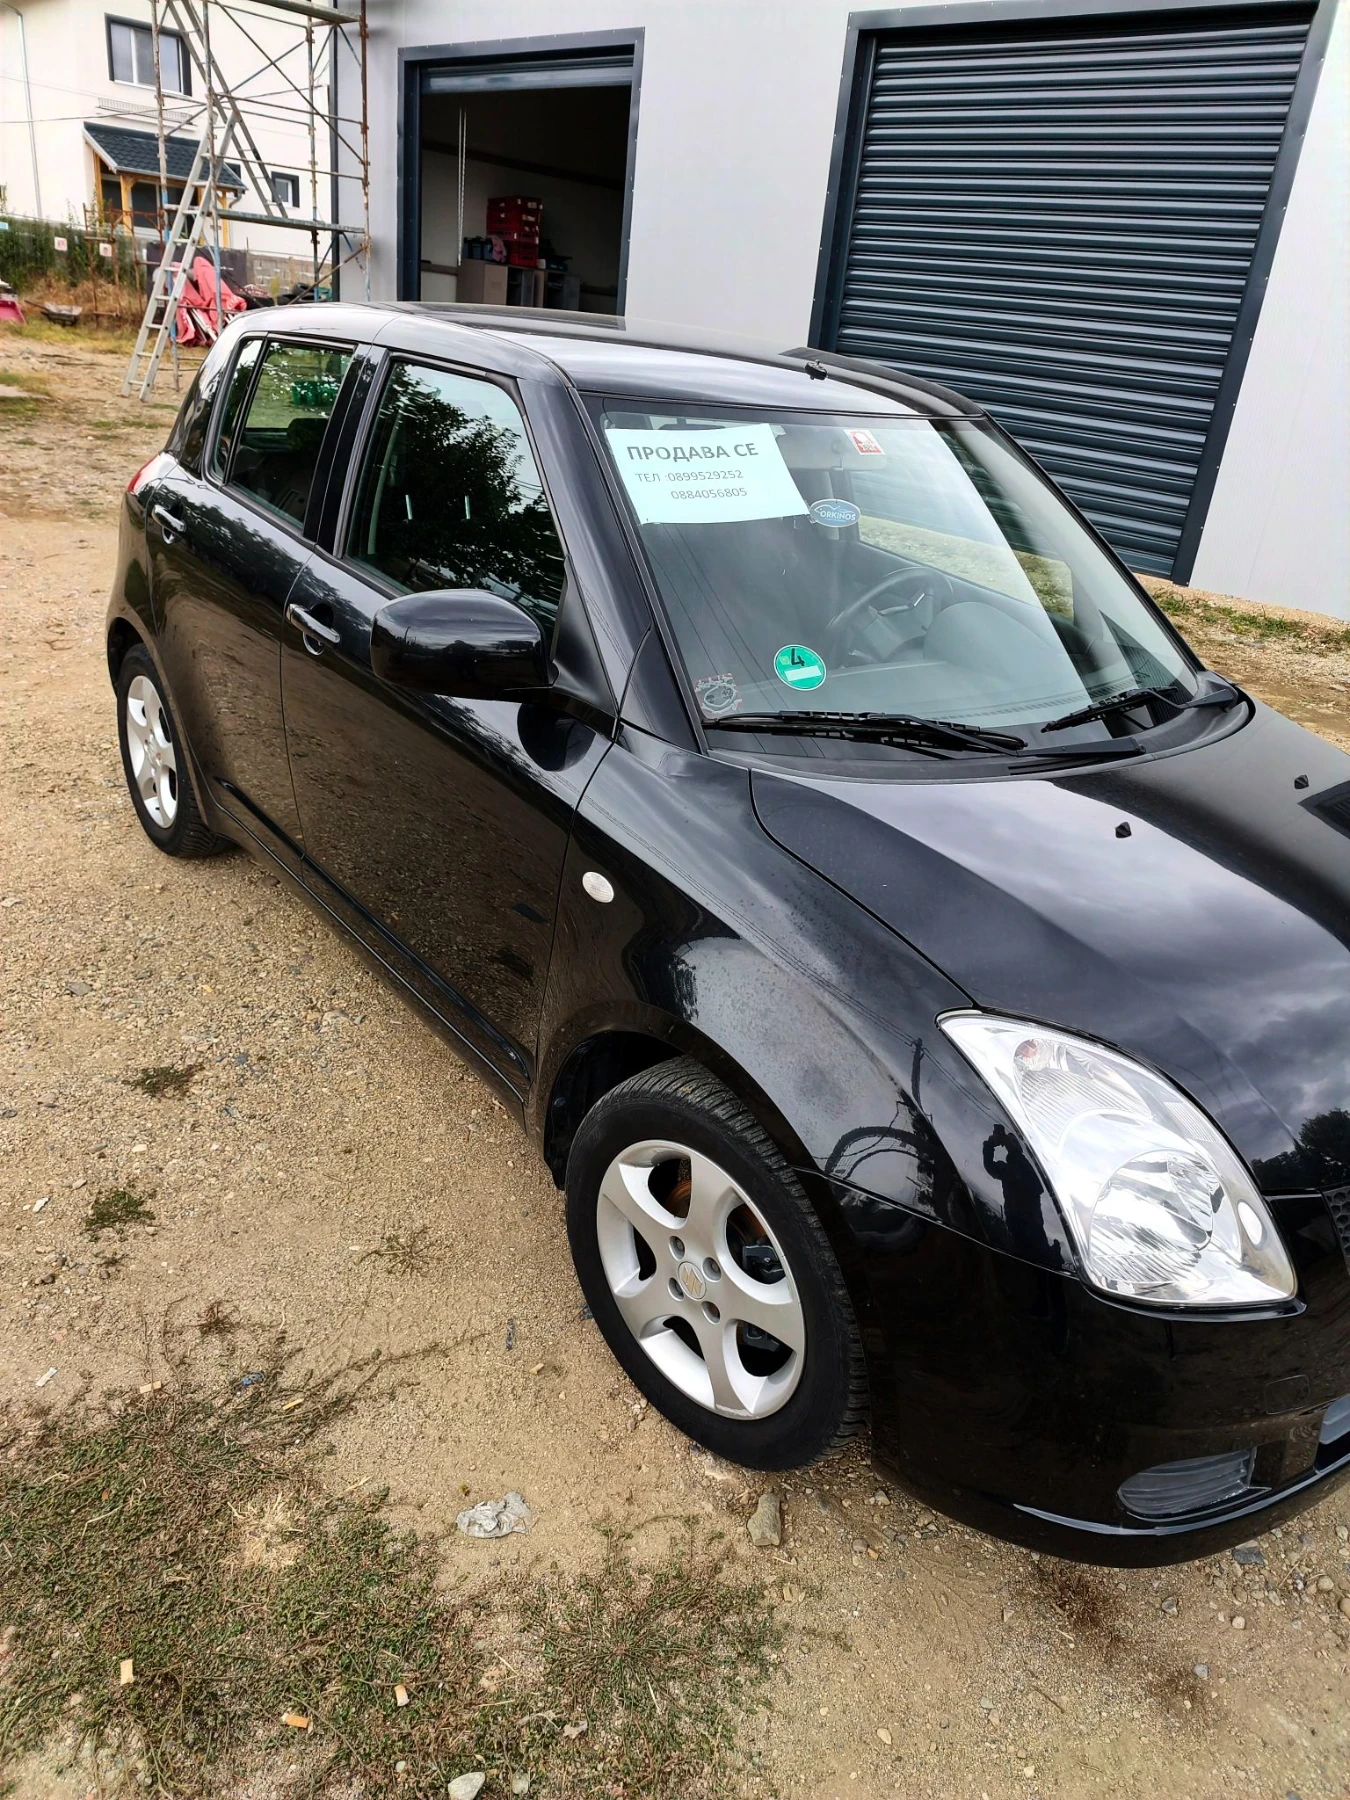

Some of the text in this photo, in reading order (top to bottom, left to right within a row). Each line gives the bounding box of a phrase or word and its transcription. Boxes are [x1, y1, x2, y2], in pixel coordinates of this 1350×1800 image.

[627, 443, 759, 463] ПРОДАВА СЕ
[635, 473, 661, 483] ТЕЛ
[670, 487, 748, 500] 0884056805
[820, 510, 857, 521] ORKINOS
[790, 648, 805, 666] 4
